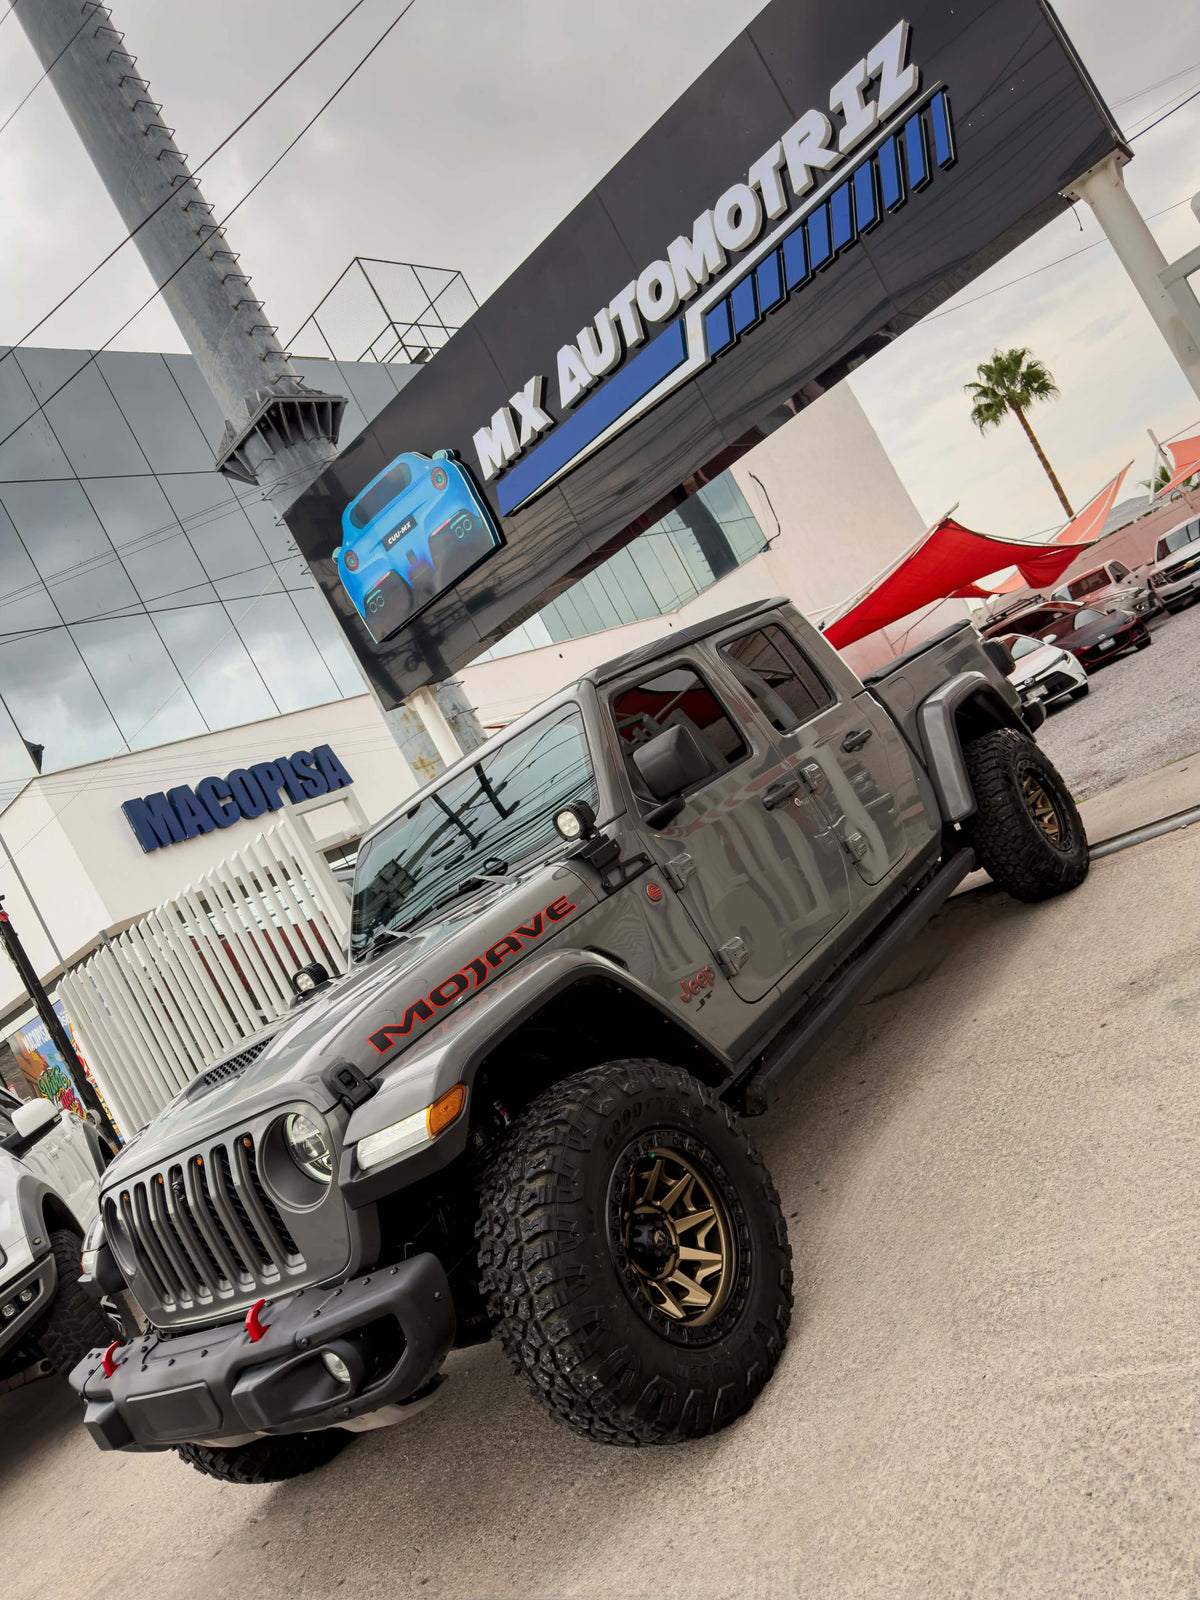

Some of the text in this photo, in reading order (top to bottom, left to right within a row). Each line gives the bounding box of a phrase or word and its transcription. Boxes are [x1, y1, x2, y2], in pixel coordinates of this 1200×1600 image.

[472, 18, 919, 482] MX AUTOMOTRIZ
[387, 520, 412, 546] CUU-MX
[121, 743, 353, 854] MACOPISA
[366, 894, 577, 1055] MOJAVE
[680, 965, 715, 1004] Jeep
